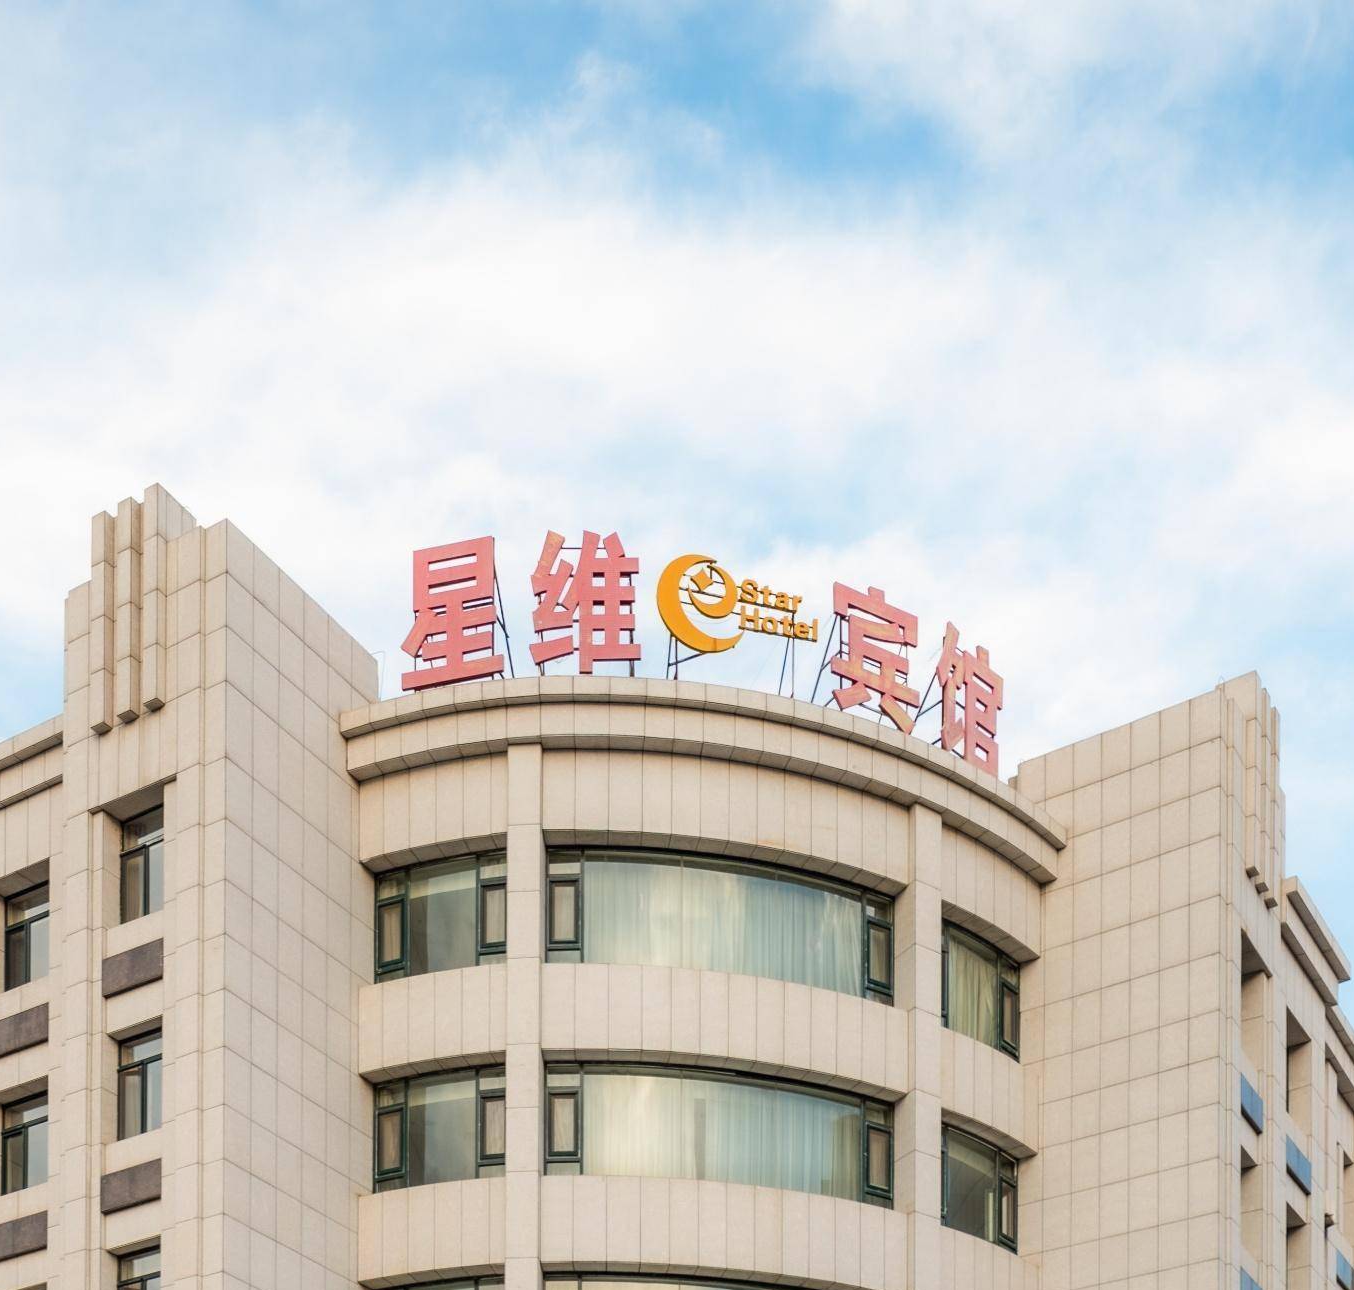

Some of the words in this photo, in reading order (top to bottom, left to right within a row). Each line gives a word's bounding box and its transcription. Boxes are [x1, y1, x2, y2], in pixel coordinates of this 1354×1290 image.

[739, 579, 803, 613] Star
[739, 605, 818, 642] Hotel
[401, 530, 641, 692] 星维
[831, 579, 1004, 776] 宾馆
